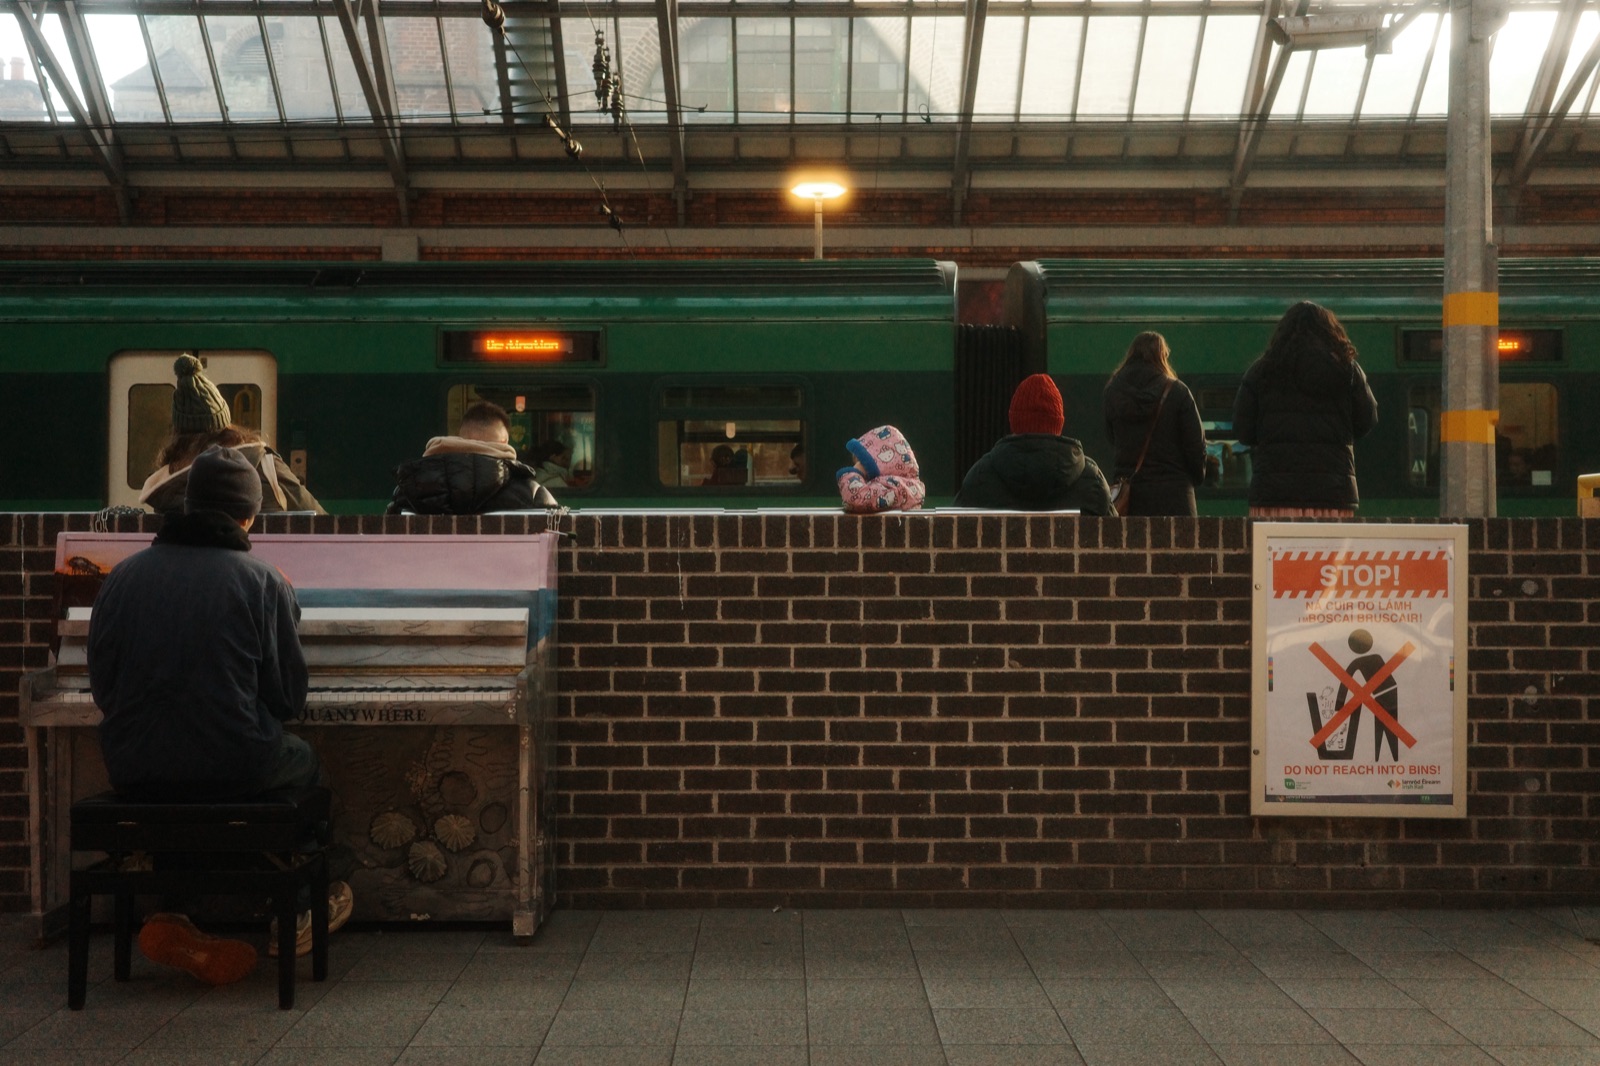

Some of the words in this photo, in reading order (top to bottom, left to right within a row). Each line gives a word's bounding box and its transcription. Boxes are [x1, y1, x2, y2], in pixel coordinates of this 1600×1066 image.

[1320, 564, 1400, 587] STOP!
[1325, 601, 1354, 611] CUIR
[1357, 601, 1375, 611] DO
[1378, 598, 1412, 611] LÁMH
[1356, 613, 1423, 623] BRUSCAIR!
[1284, 765, 1302, 775] DO
[1304, 765, 1329, 775] NOT
[1333, 765, 1374, 775] REACH
[1377, 765, 1405, 775] INTO
[1409, 765, 1441, 775] BINS!
